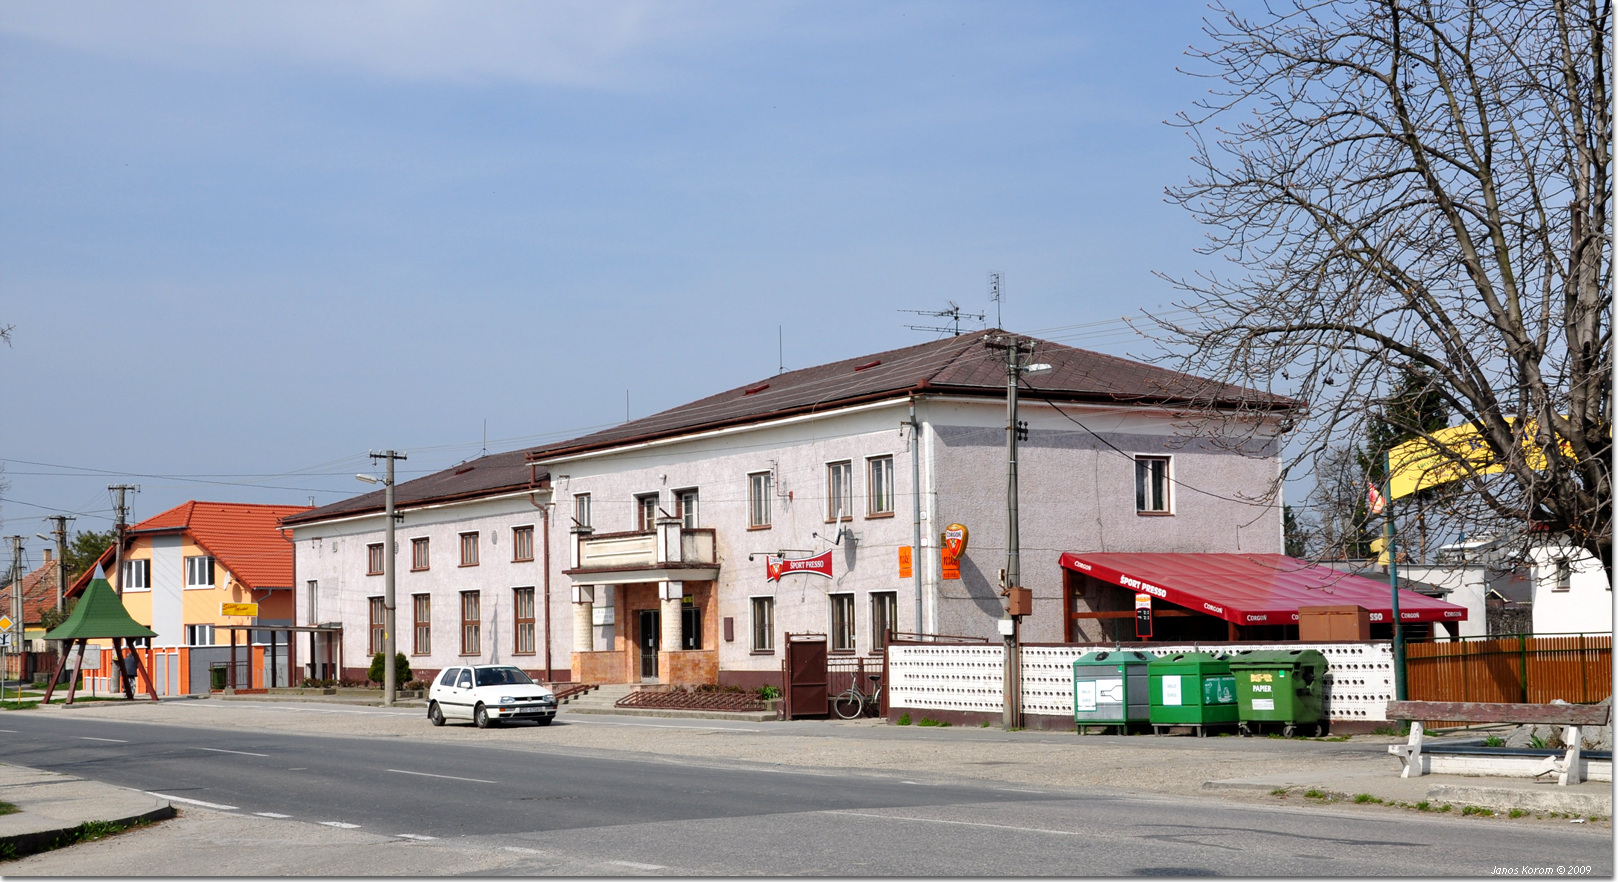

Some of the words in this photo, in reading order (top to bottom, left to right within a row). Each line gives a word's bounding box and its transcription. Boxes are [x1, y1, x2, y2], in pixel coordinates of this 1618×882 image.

[806, 560, 824, 569] PRESSO
[1120, 574, 1142, 590] ŠPORT
[1141, 582, 1167, 598] PRESSO
[1369, 612, 1383, 621] SSO
[1252, 684, 1272, 693] PAPIER
